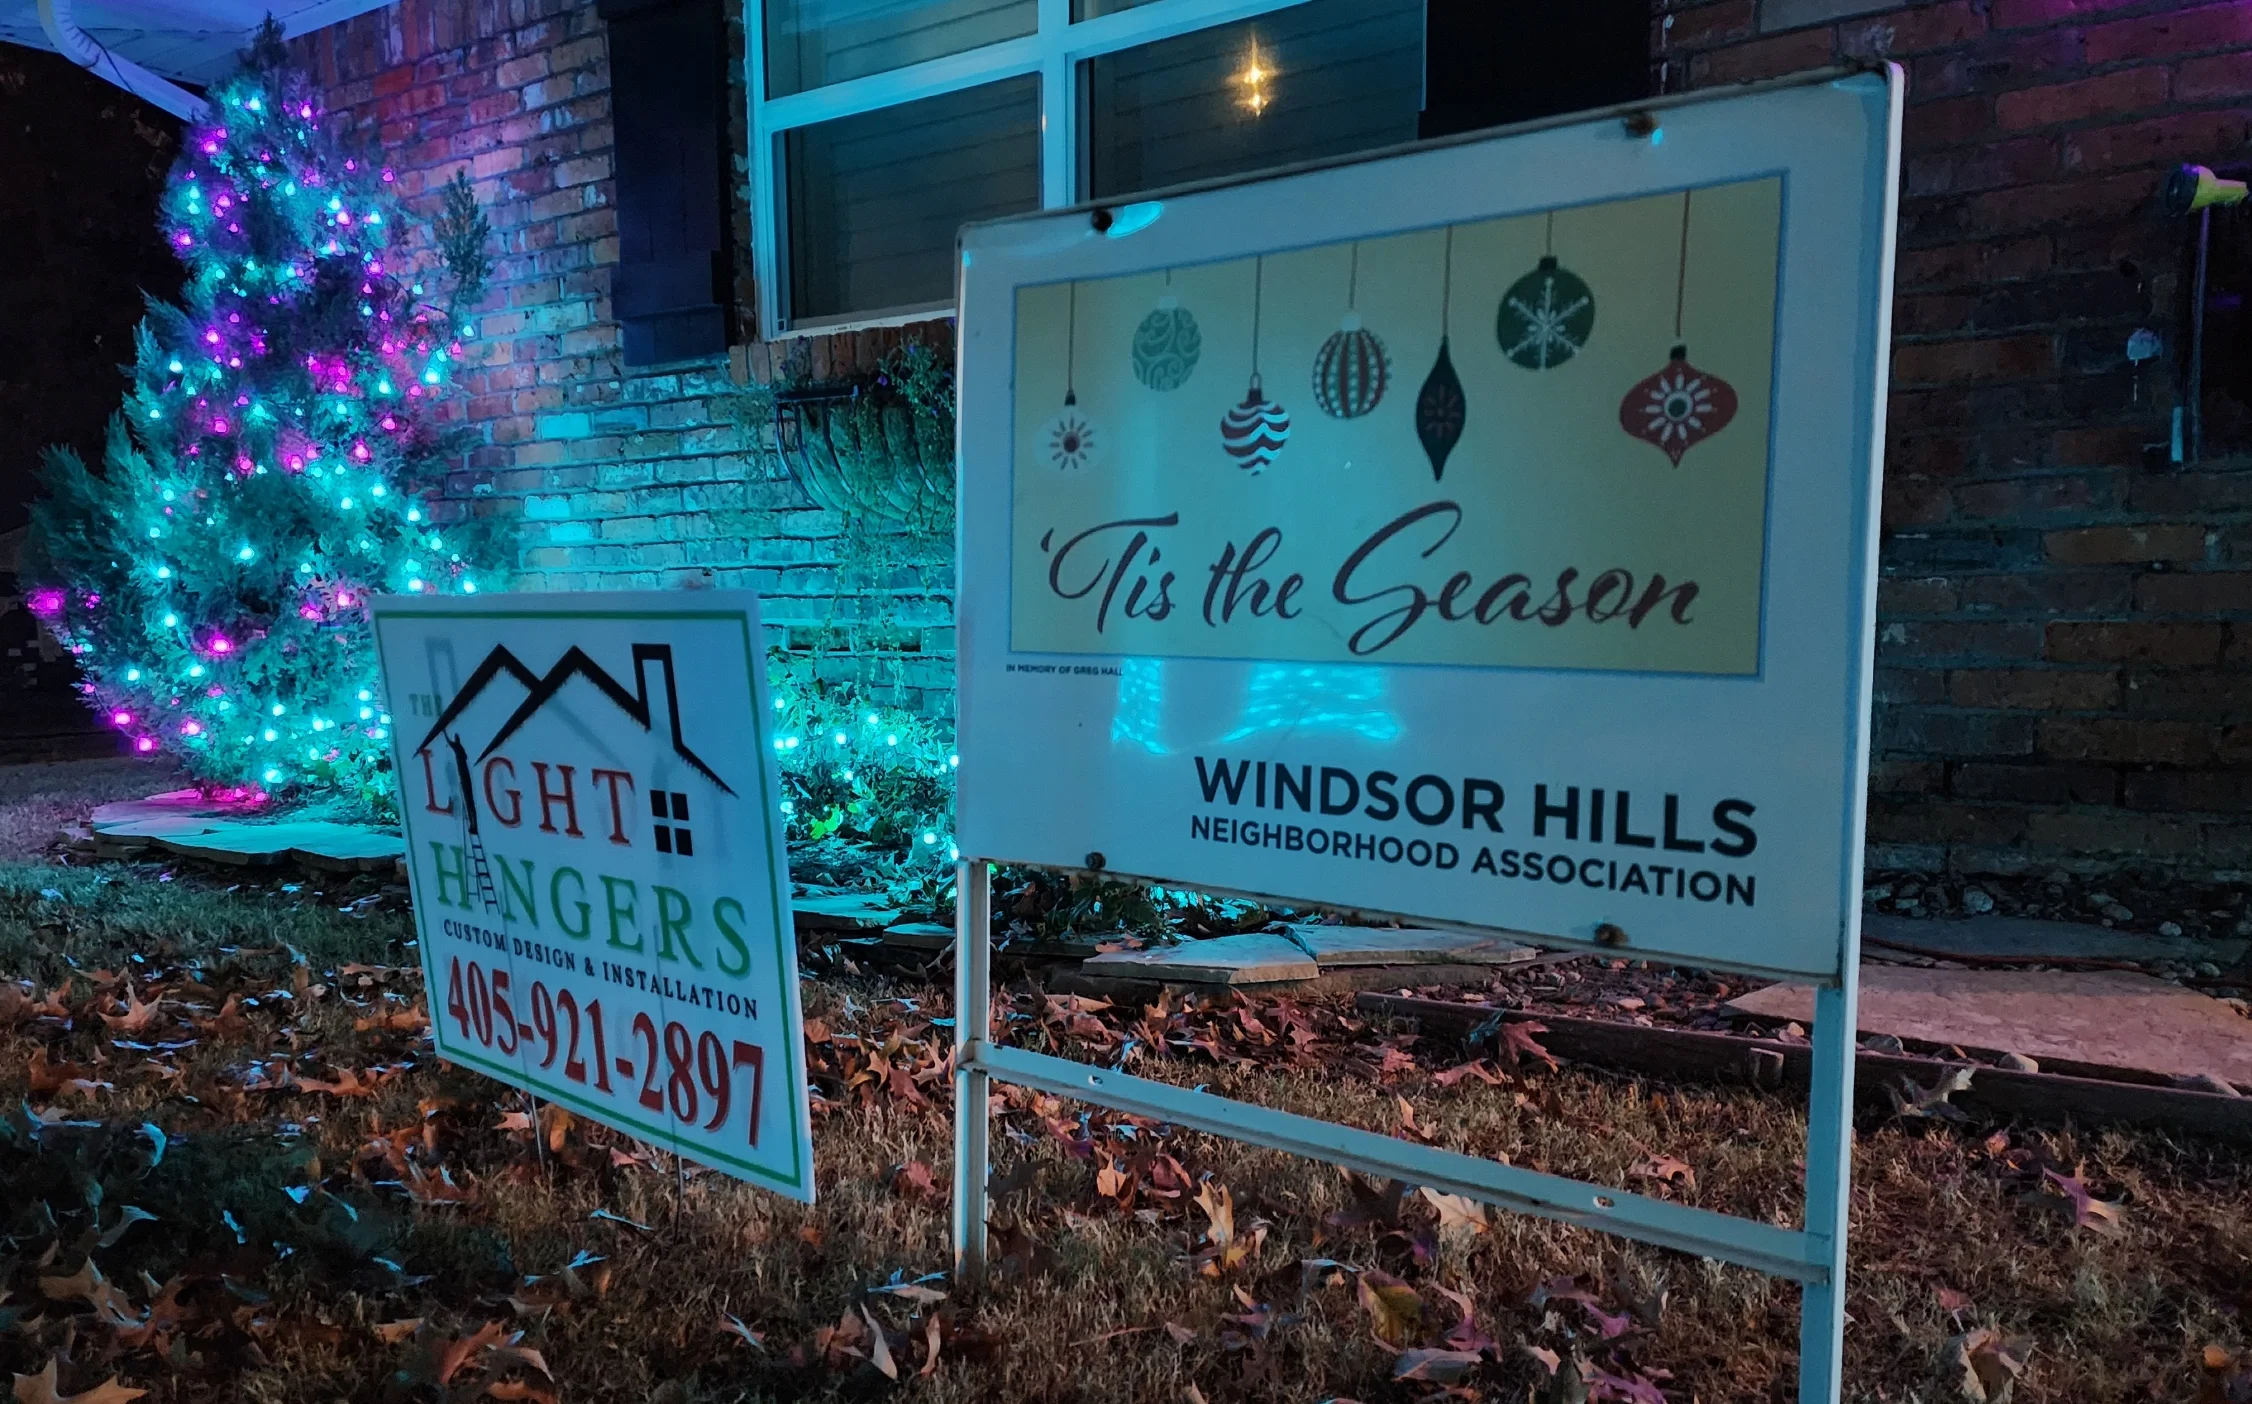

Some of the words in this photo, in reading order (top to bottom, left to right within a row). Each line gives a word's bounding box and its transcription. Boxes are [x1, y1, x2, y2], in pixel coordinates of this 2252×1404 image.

[1202, 526, 1304, 628] the
[1332, 499, 1702, 656] Season
[1006, 663, 1015, 673] IN
[1017, 664, 1055, 674] MEMORY
[1058, 665, 1071, 675] OF
[1073, 666, 1099, 676] GREG
[1193, 756, 1504, 834] WINDSOR
[1533, 783, 1758, 859] HILLS
[1190, 814, 1460, 870] NEIGHBORHOOD
[1471, 846, 1756, 907] ASSOCIATION
[443, 918, 506, 952] CUSTOM
[512, 937, 576, 972] DESIGN
[584, 956, 596, 977] &
[602, 961, 758, 1021] INSTALLATION
[447, 955, 764, 1150] 405-921-2897
